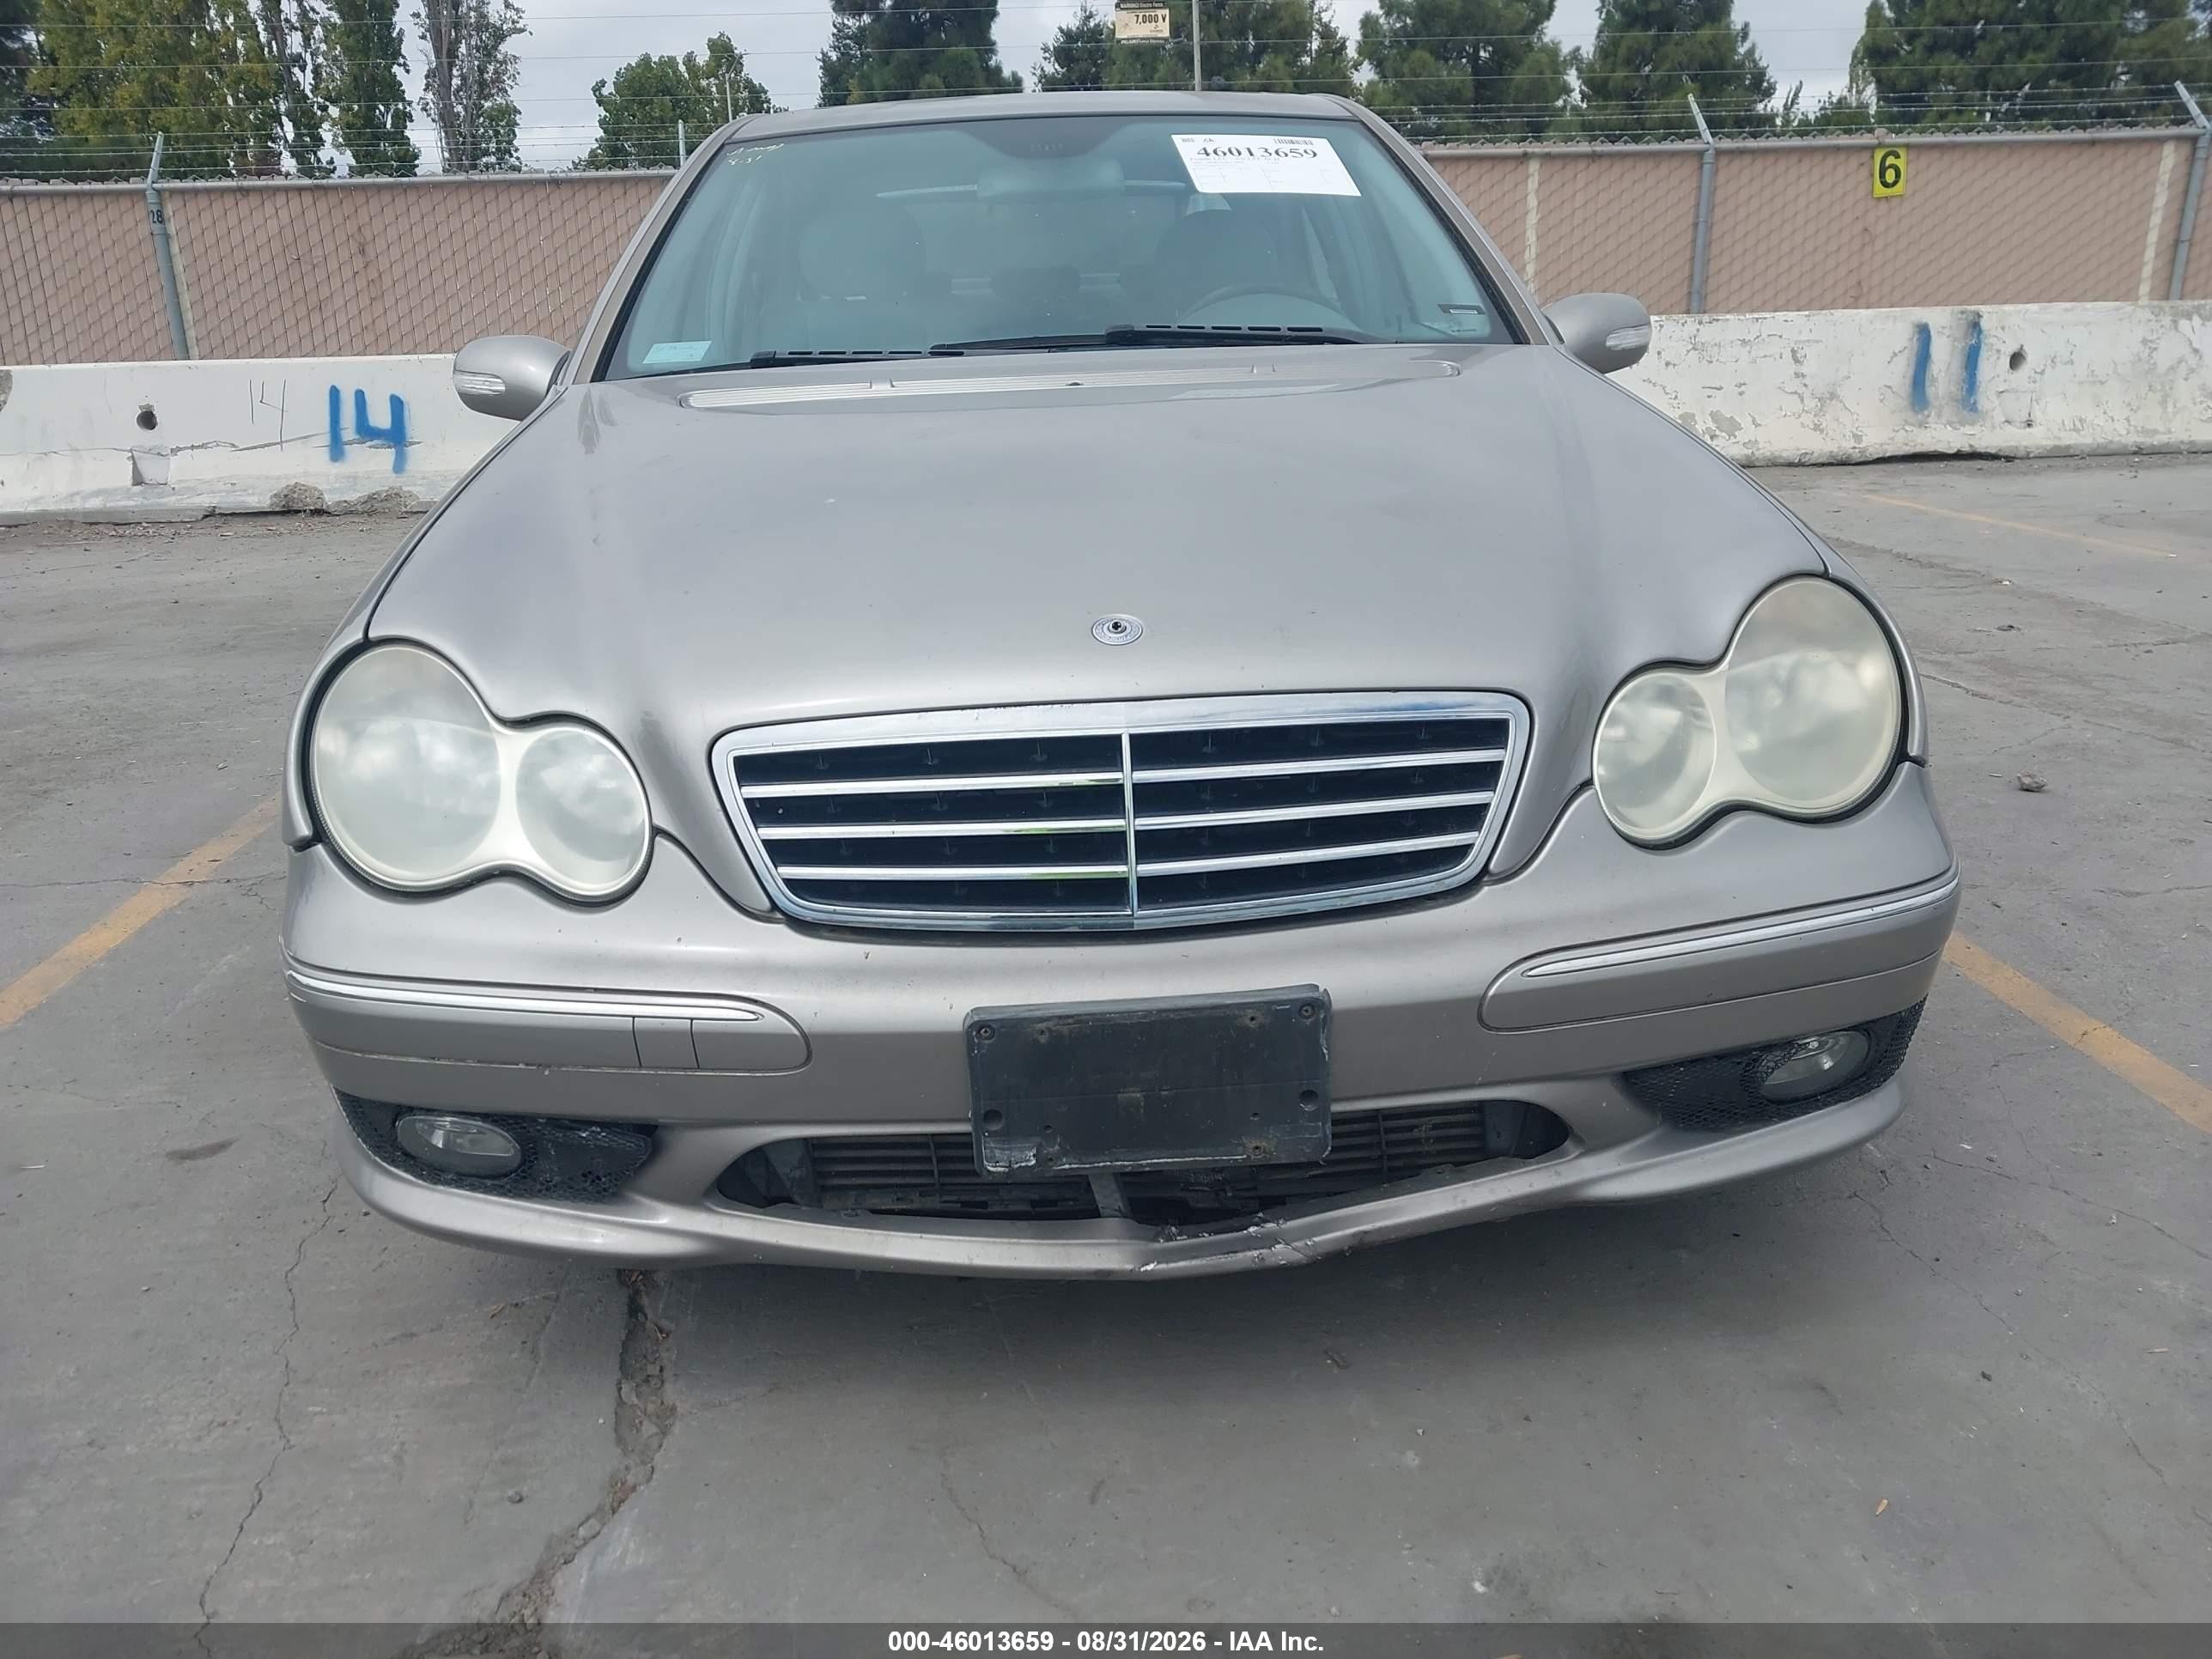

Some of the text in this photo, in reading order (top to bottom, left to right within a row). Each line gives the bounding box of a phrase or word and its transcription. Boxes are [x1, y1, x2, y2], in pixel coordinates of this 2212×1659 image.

[1134, 13, 1167, 25] 7,000 V
[1197, 145, 1318, 159] 46013659
[1879, 149, 1902, 189] 6
[149, 209, 164, 224] 28
[1911, 315, 1984, 413] 11
[249, 378, 289, 452] 14
[328, 384, 409, 475] 14
